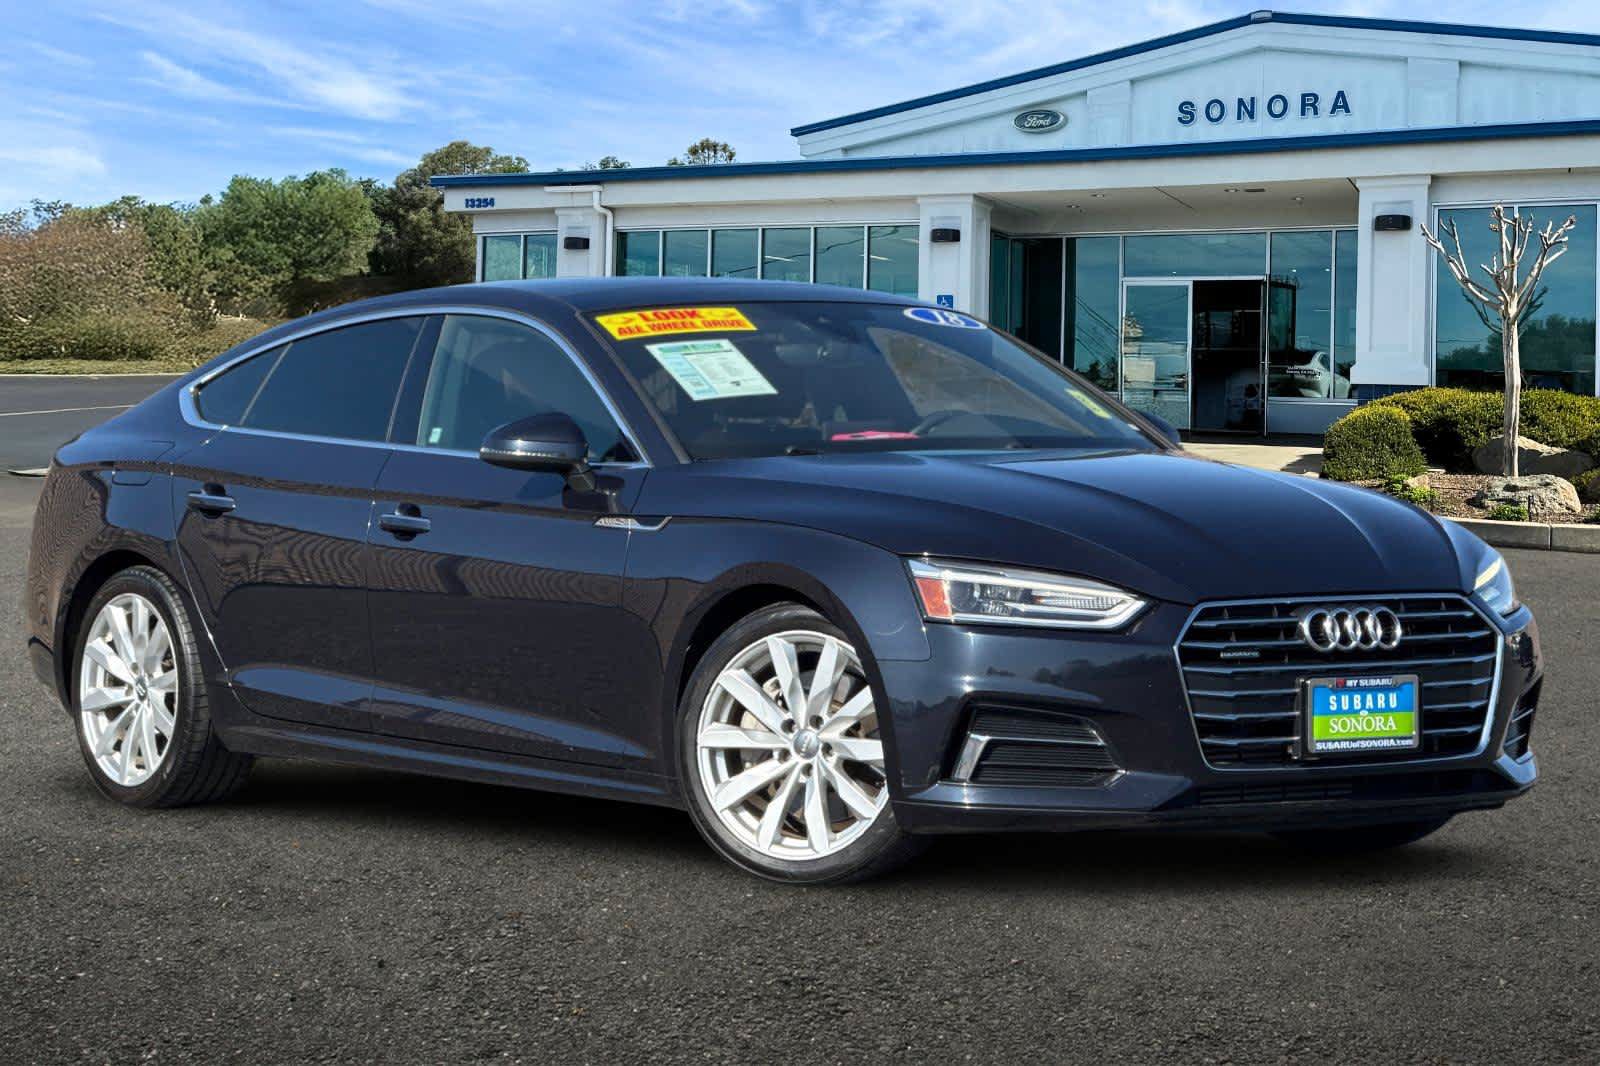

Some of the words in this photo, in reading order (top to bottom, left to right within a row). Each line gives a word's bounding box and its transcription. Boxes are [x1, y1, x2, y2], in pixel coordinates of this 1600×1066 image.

[1177, 90, 1352, 126] SONORA
[1024, 114, 1052, 129] Ford
[638, 309, 703, 322] LOOK
[617, 326, 647, 336] ALL
[648, 321, 699, 331] WHEEL
[702, 319, 749, 328] DRIVE
[1329, 692, 1398, 711] SUBARU
[1329, 715, 1397, 734] SONORA
